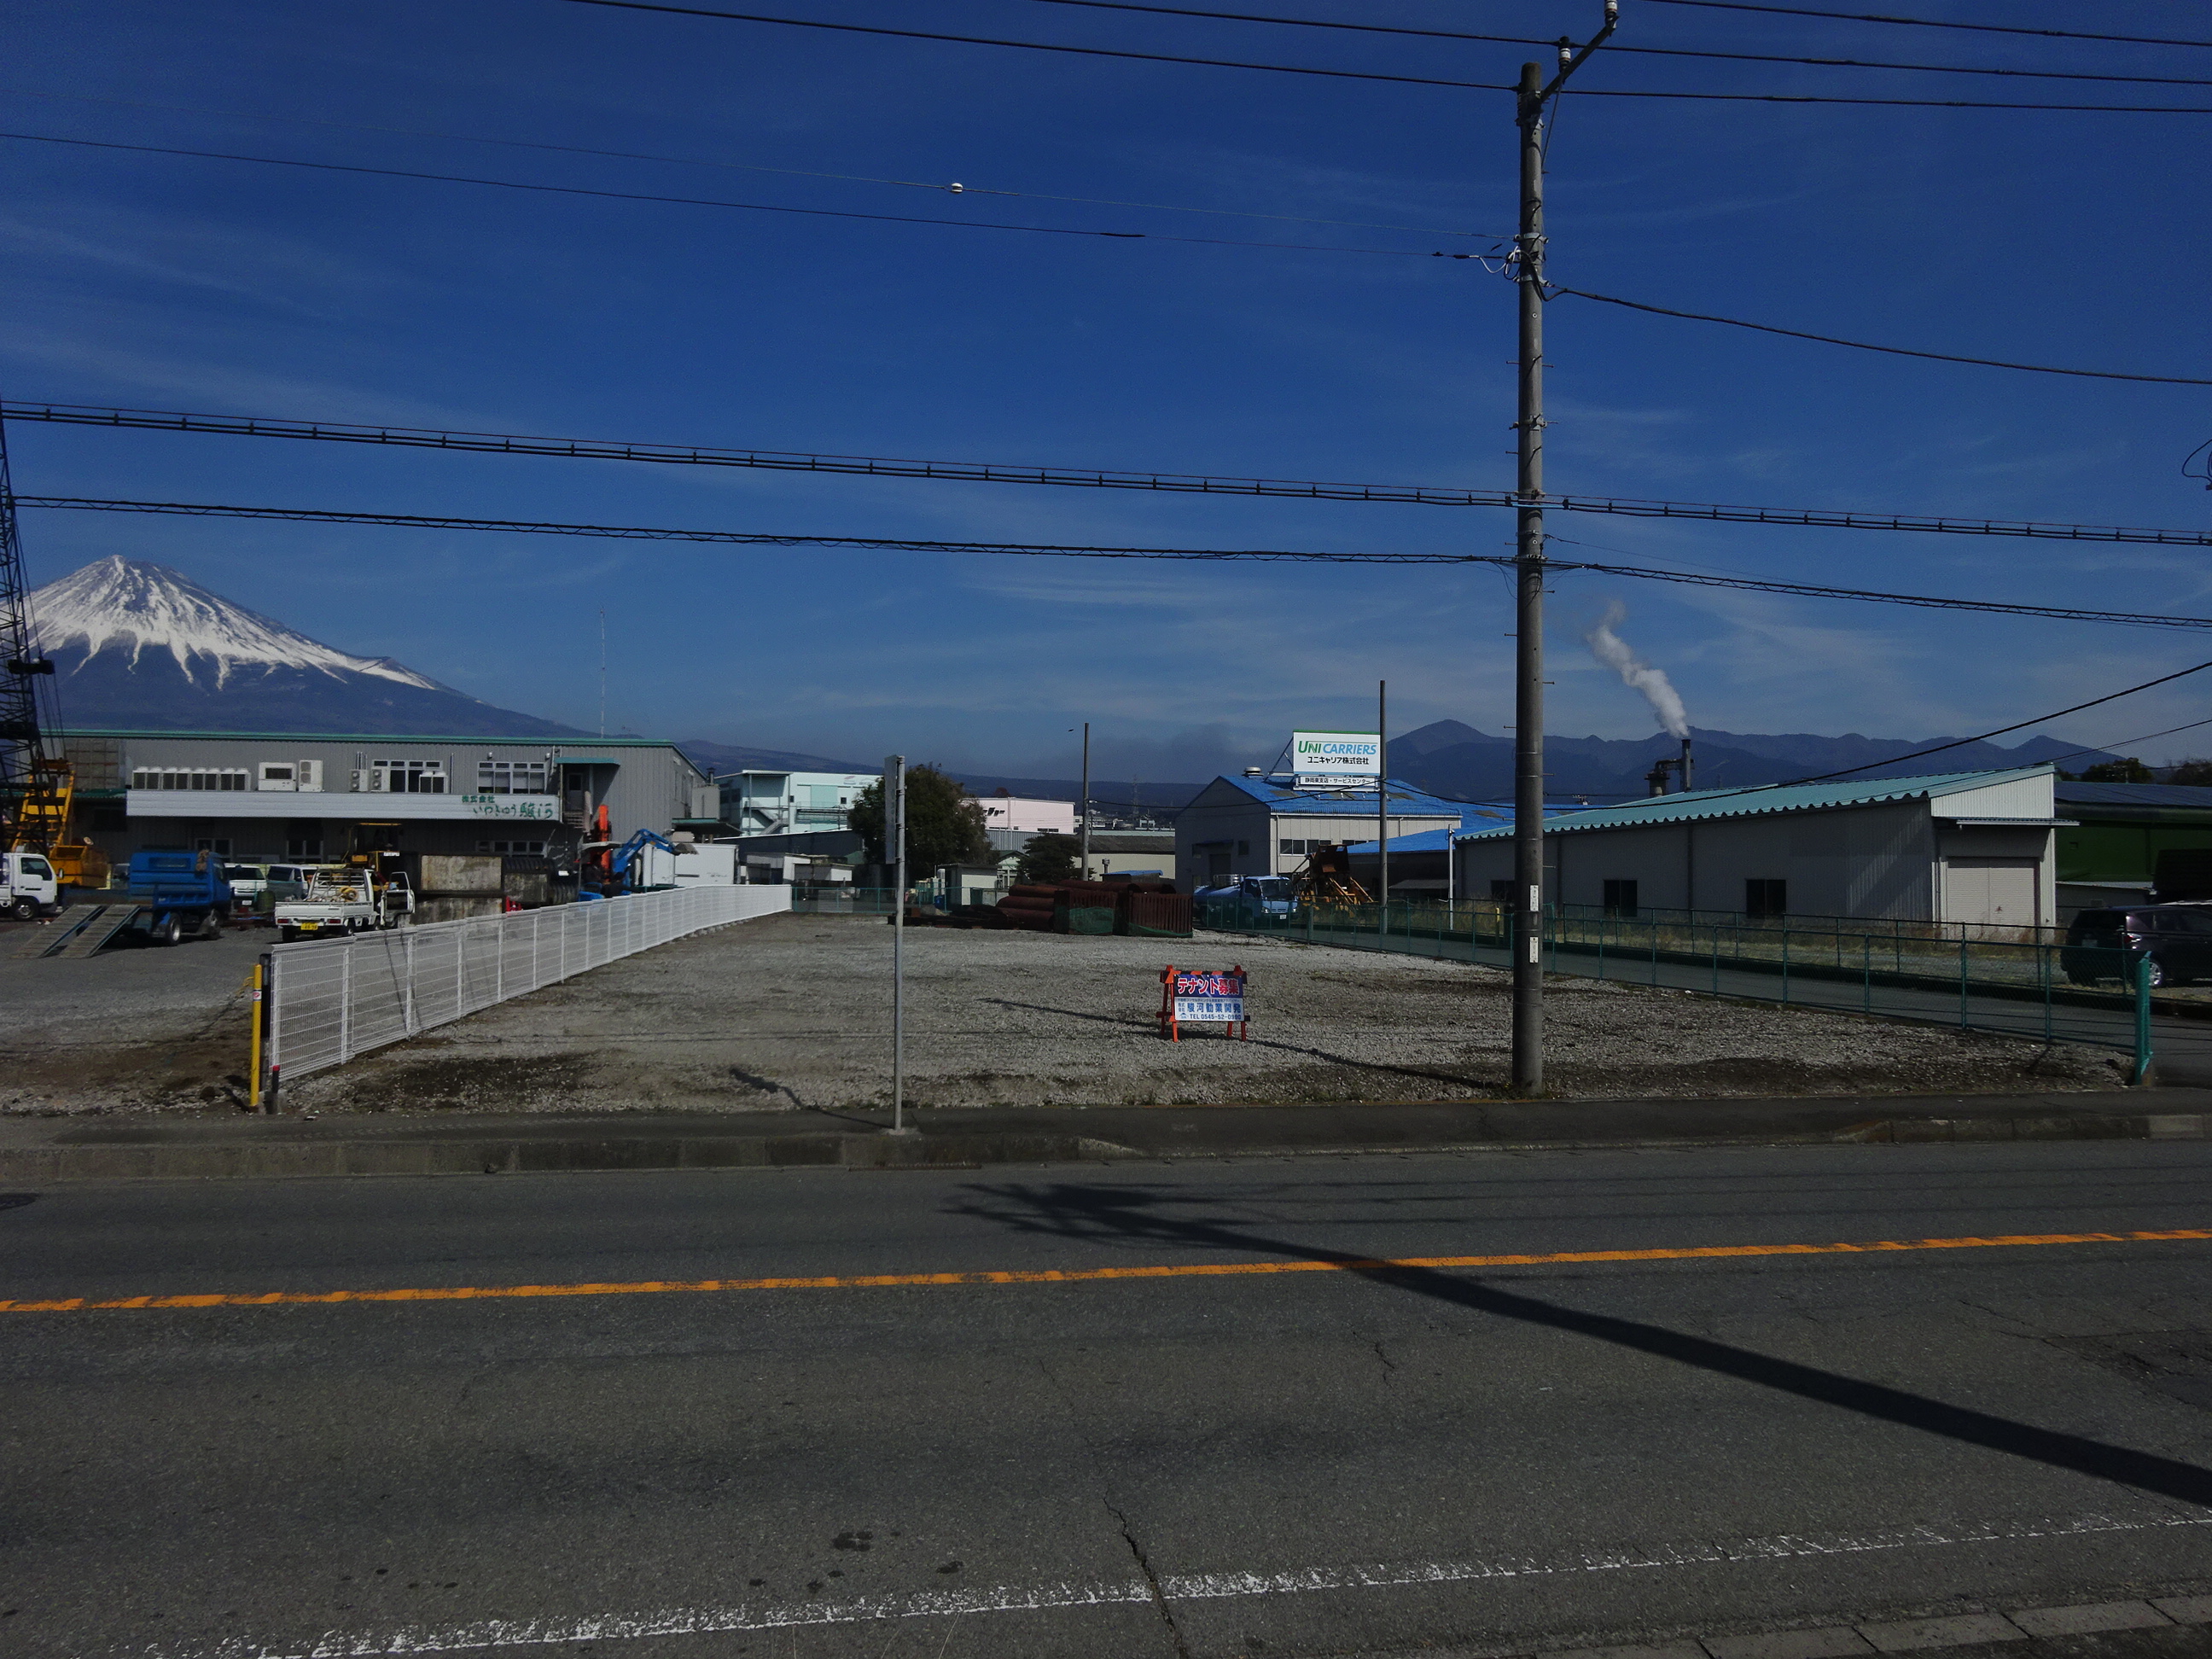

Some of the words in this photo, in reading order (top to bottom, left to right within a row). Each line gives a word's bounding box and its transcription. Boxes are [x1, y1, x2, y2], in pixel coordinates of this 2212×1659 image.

[1177, 978, 1239, 995] テナント募集
